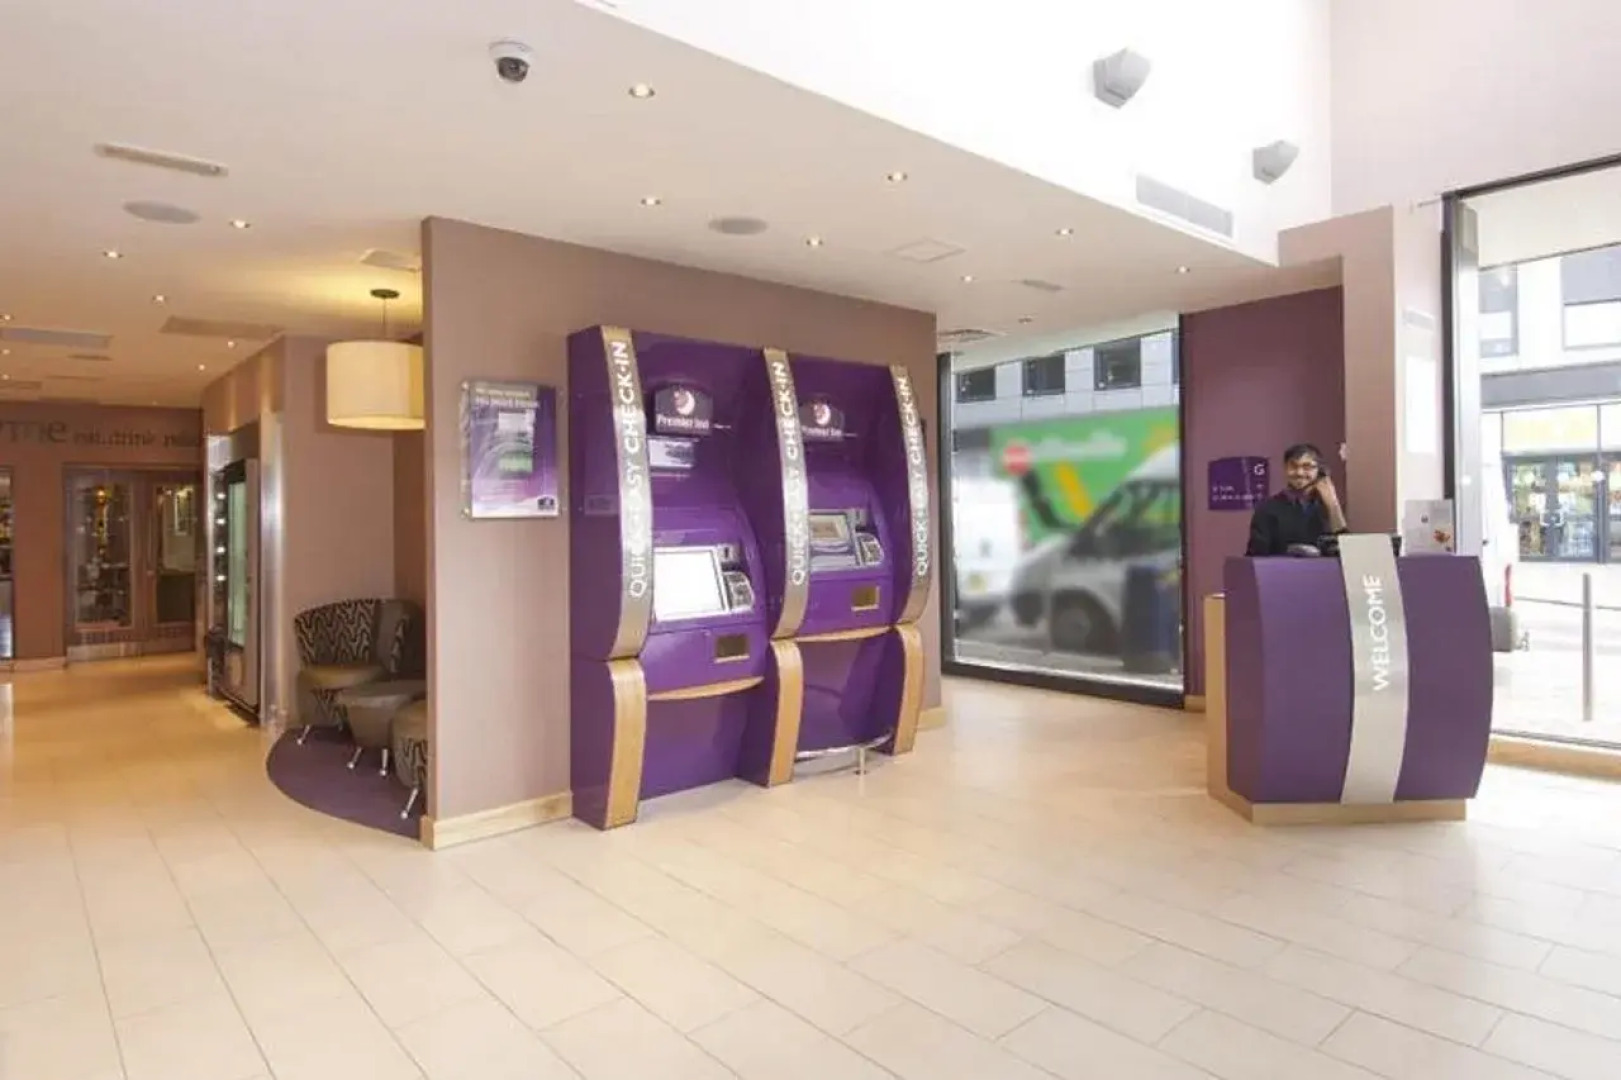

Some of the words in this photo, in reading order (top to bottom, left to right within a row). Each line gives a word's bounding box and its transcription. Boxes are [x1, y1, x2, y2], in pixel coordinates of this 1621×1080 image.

[611, 341, 641, 454] CHECK-IN
[771, 361, 799, 461] CHECK-IN
[897, 376, 922, 465] CHECK-IN
[1253, 463, 1266, 476] G
[1362, 573, 1391, 692] WELCOME
